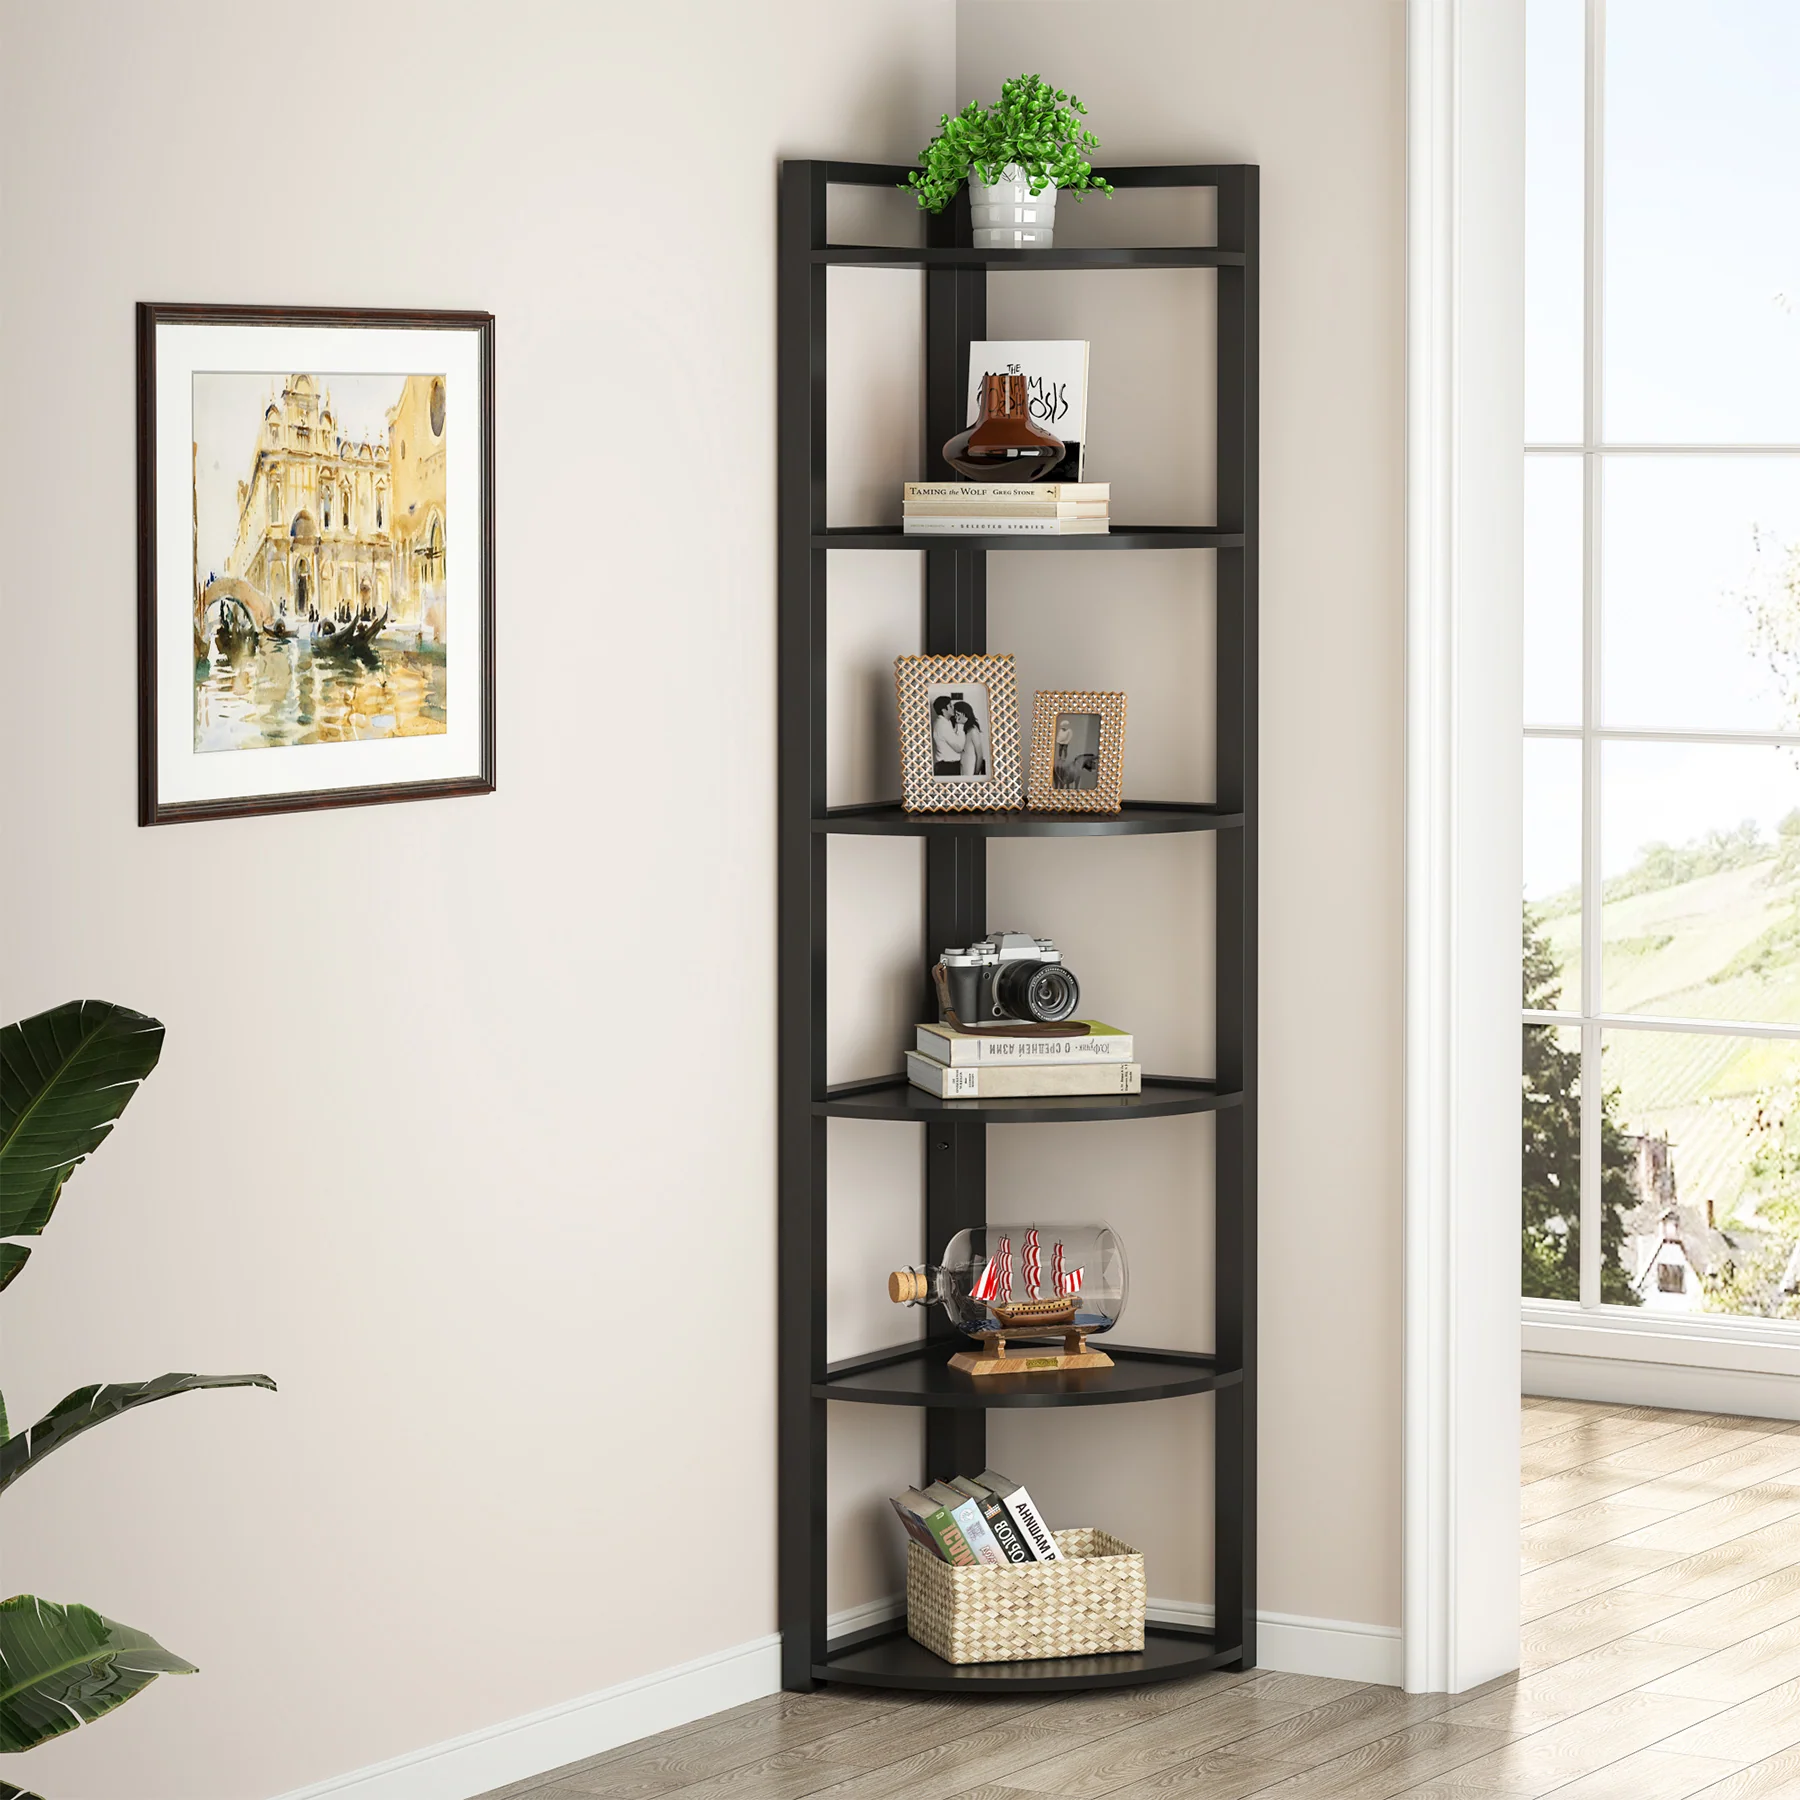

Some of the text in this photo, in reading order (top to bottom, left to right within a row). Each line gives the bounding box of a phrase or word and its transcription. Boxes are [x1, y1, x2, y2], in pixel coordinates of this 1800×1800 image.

[1007, 363, 1021, 374] THE
[910, 487, 947, 495] TAMING
[949, 487, 959, 495] the
[960, 487, 987, 495] WOLF
[989, 1043, 1015, 1055] АЗИИ
[1018, 1042, 1061, 1057] СРЕДНЕЙ
